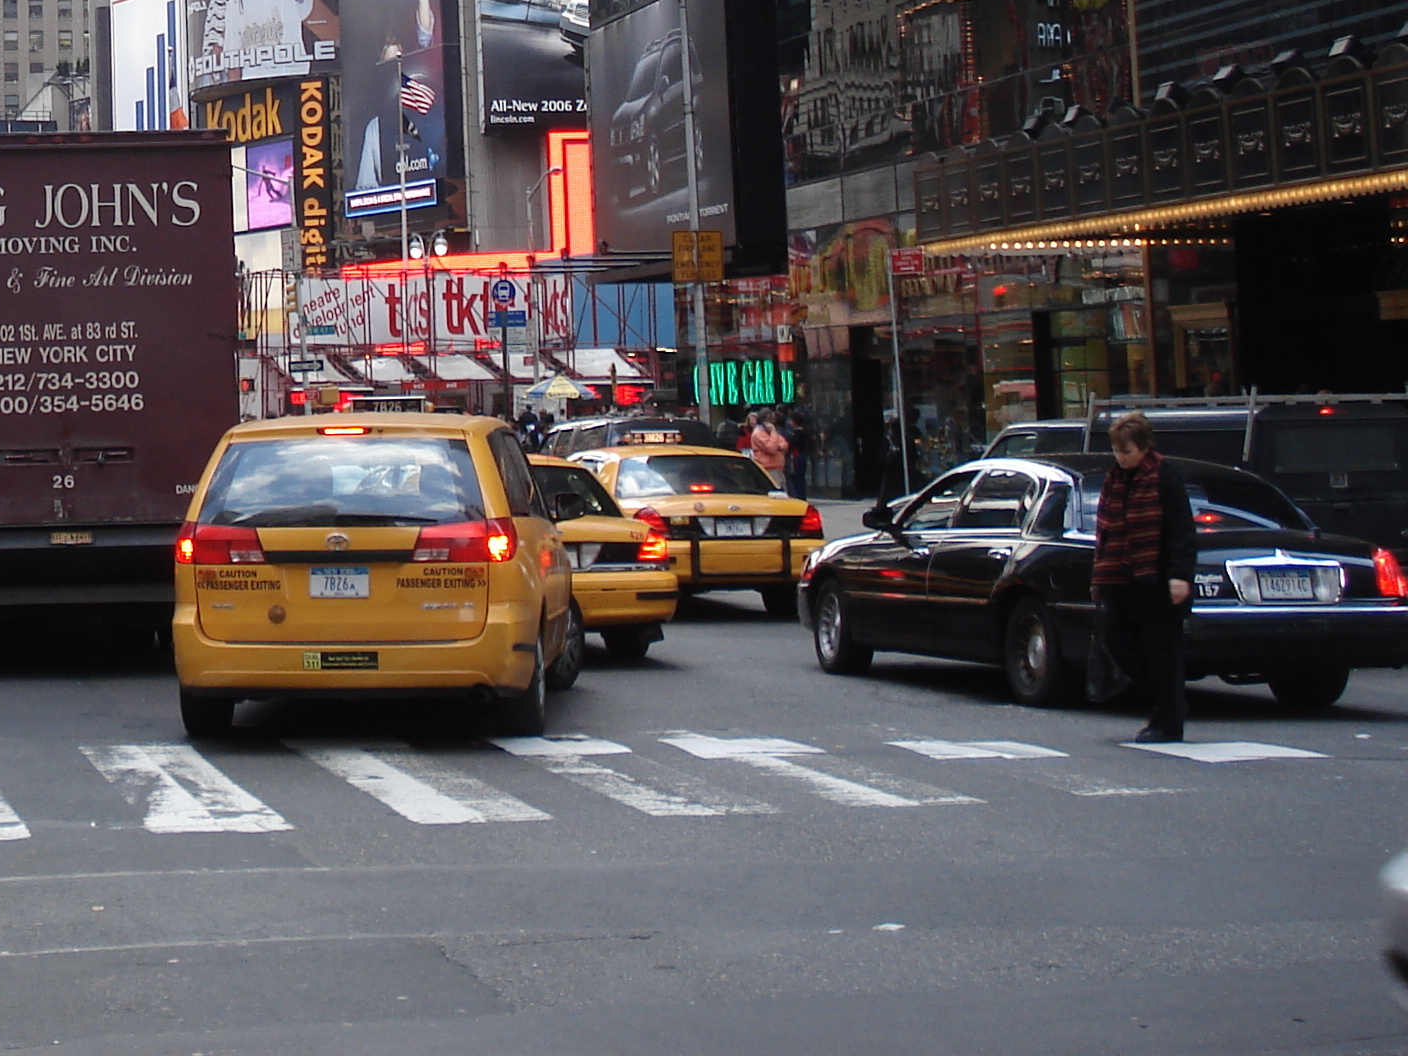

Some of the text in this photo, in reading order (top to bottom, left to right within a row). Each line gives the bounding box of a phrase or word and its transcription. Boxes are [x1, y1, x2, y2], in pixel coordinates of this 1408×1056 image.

[196, 40, 336, 77] SOUTHPOLE
[490, 99, 573, 113] All-New 2006
[205, 87, 283, 143] Kodak
[490, 115, 535, 125] lincoln.com
[300, 80, 324, 190] KODAK
[36, 181, 201, 229] JOHN'S
[91, 235, 137, 253] INC.
[7, 267, 24, 294] &
[33, 266, 76, 289] Fine
[82, 266, 119, 289] Art
[123, 264, 194, 287] Division
[43, 324, 67, 341] AVE.
[71, 324, 82, 340] at
[86, 323, 102, 340] 83
[105, 323, 117, 339] rd
[120, 322, 139, 339] ST.
[38, 347, 89, 365] YORK
[96, 345, 137, 363] CITY
[52, 475, 74, 489] 26
[219, 570, 258, 579] CAUTION
[423, 567, 464, 577] CAUTION
[205, 580, 282, 591] PASSENGER EXITING
[396, 577, 476, 589] PASSENGER EXITING
[1198, 584, 1220, 597] 157
